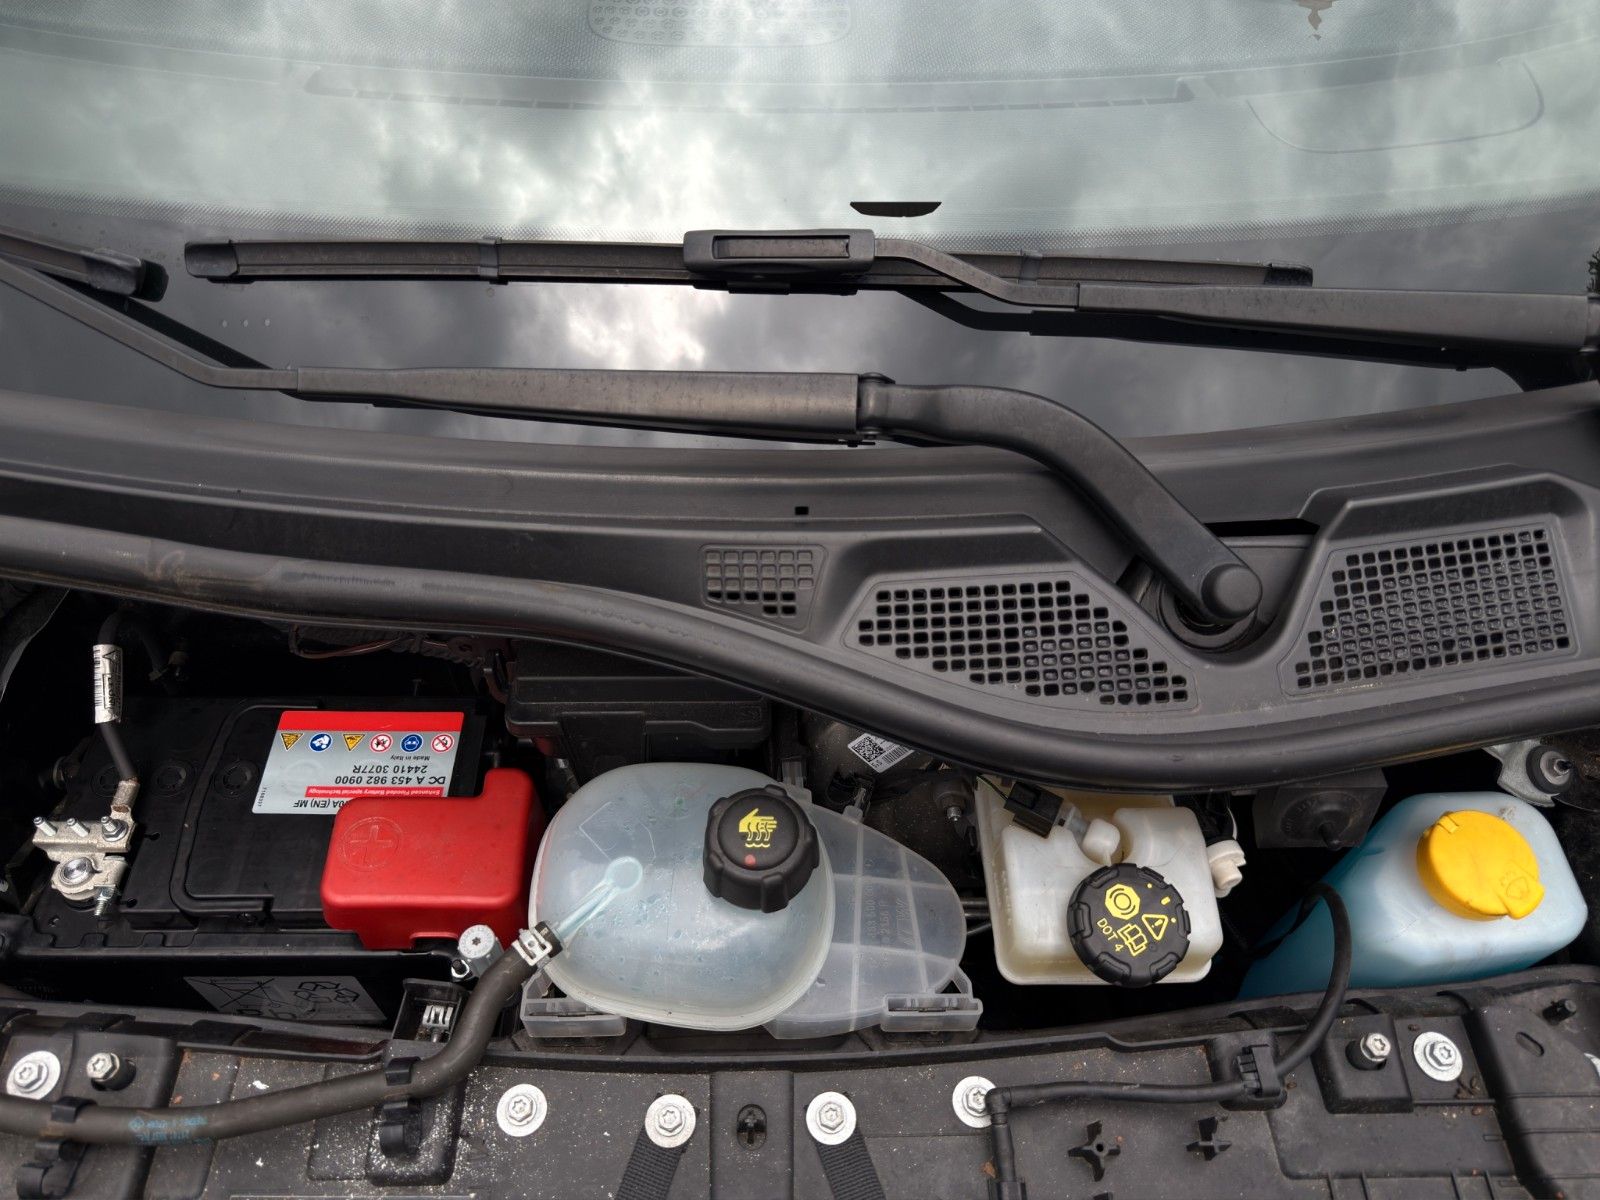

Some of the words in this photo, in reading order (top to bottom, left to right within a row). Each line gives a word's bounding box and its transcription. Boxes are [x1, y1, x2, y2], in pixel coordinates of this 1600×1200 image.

[352, 765, 390, 774] 3077R
[393, 765, 428, 774] 24410
[335, 776, 363, 785] 0900
[366, 776, 387, 785] 982
[391, 776, 412, 784] 453
[416, 776, 425, 784] A
[428, 776, 446, 784] DC
[308, 787, 341, 795] technology
[364, 788, 385, 796] Battery
[293, 800, 308, 808] MF
[310, 799, 331, 808] (EN)
[332, 800, 349, 808] 0A
[1097, 918, 1118, 941] DOT
[1114, 943, 1124, 952] 4
